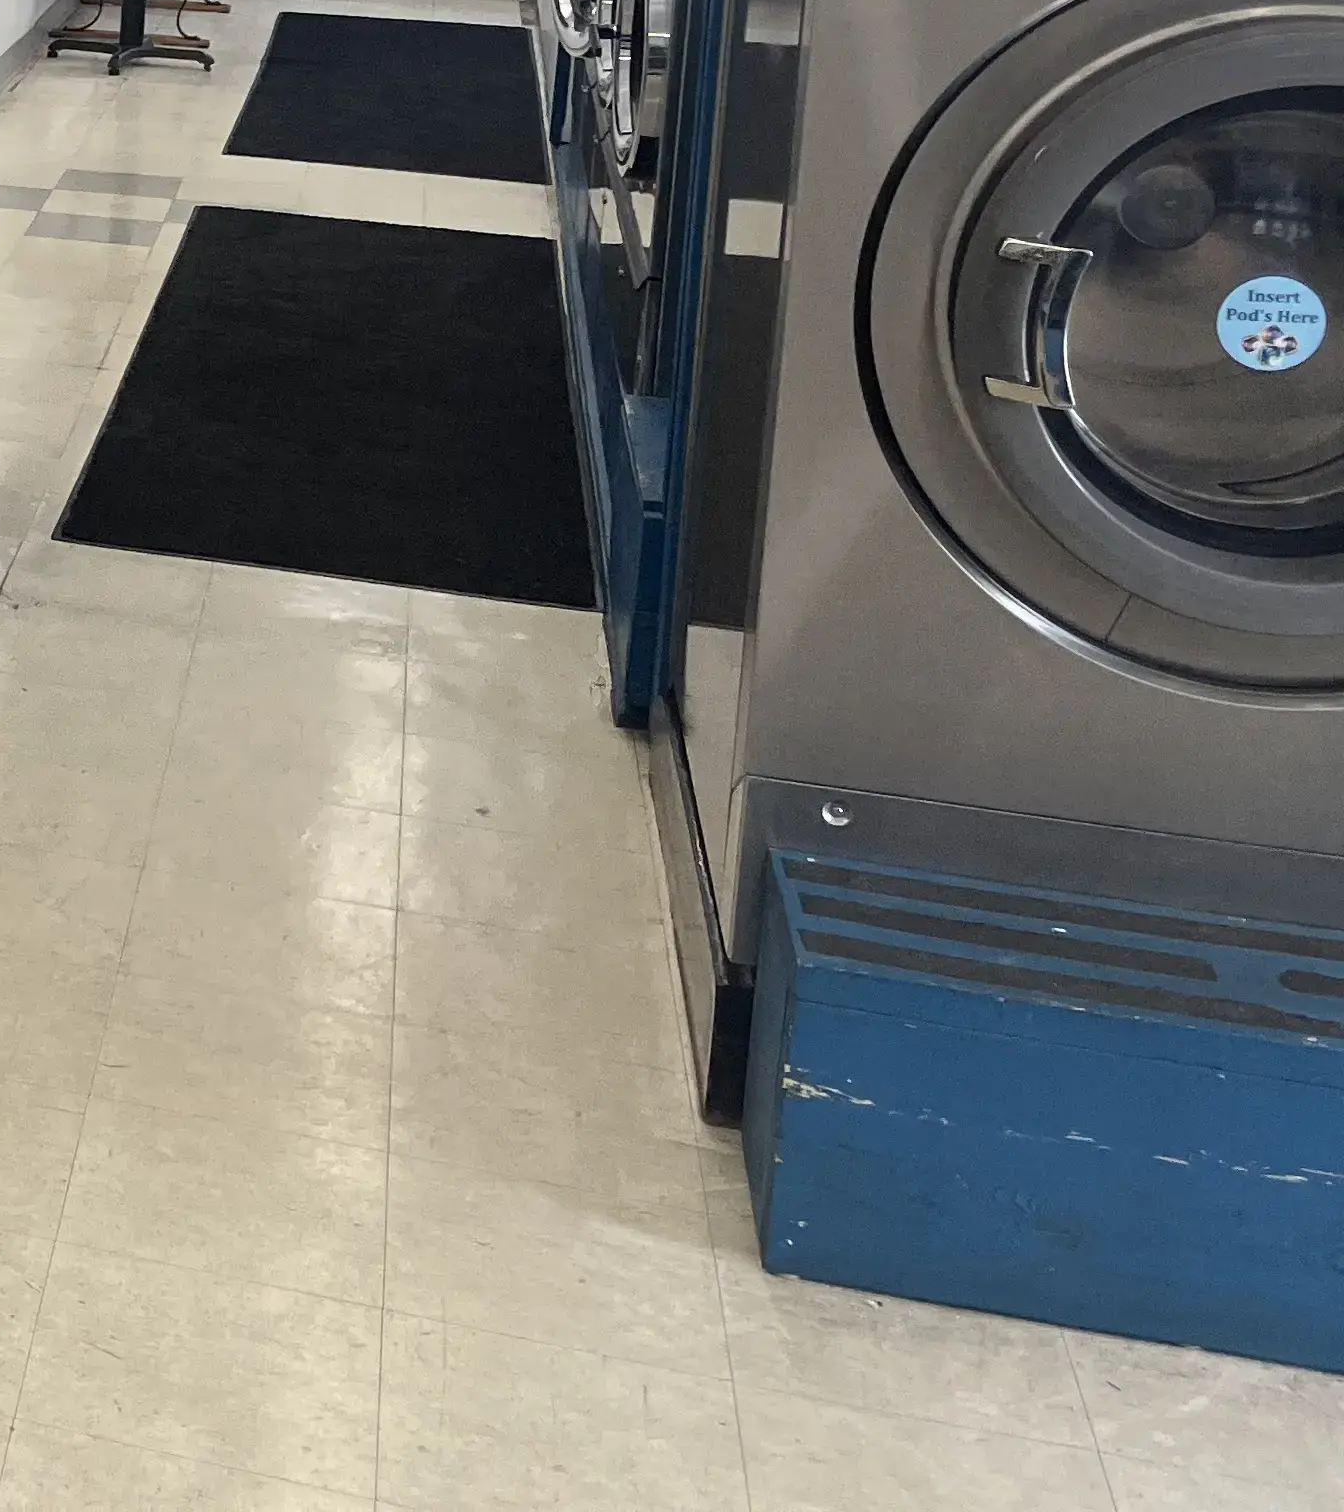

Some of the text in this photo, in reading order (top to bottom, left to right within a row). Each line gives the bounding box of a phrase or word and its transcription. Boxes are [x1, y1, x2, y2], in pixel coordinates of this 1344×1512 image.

[1247, 289, 1301, 305] Insert
[1225, 307, 1319, 324] Pod's Here
